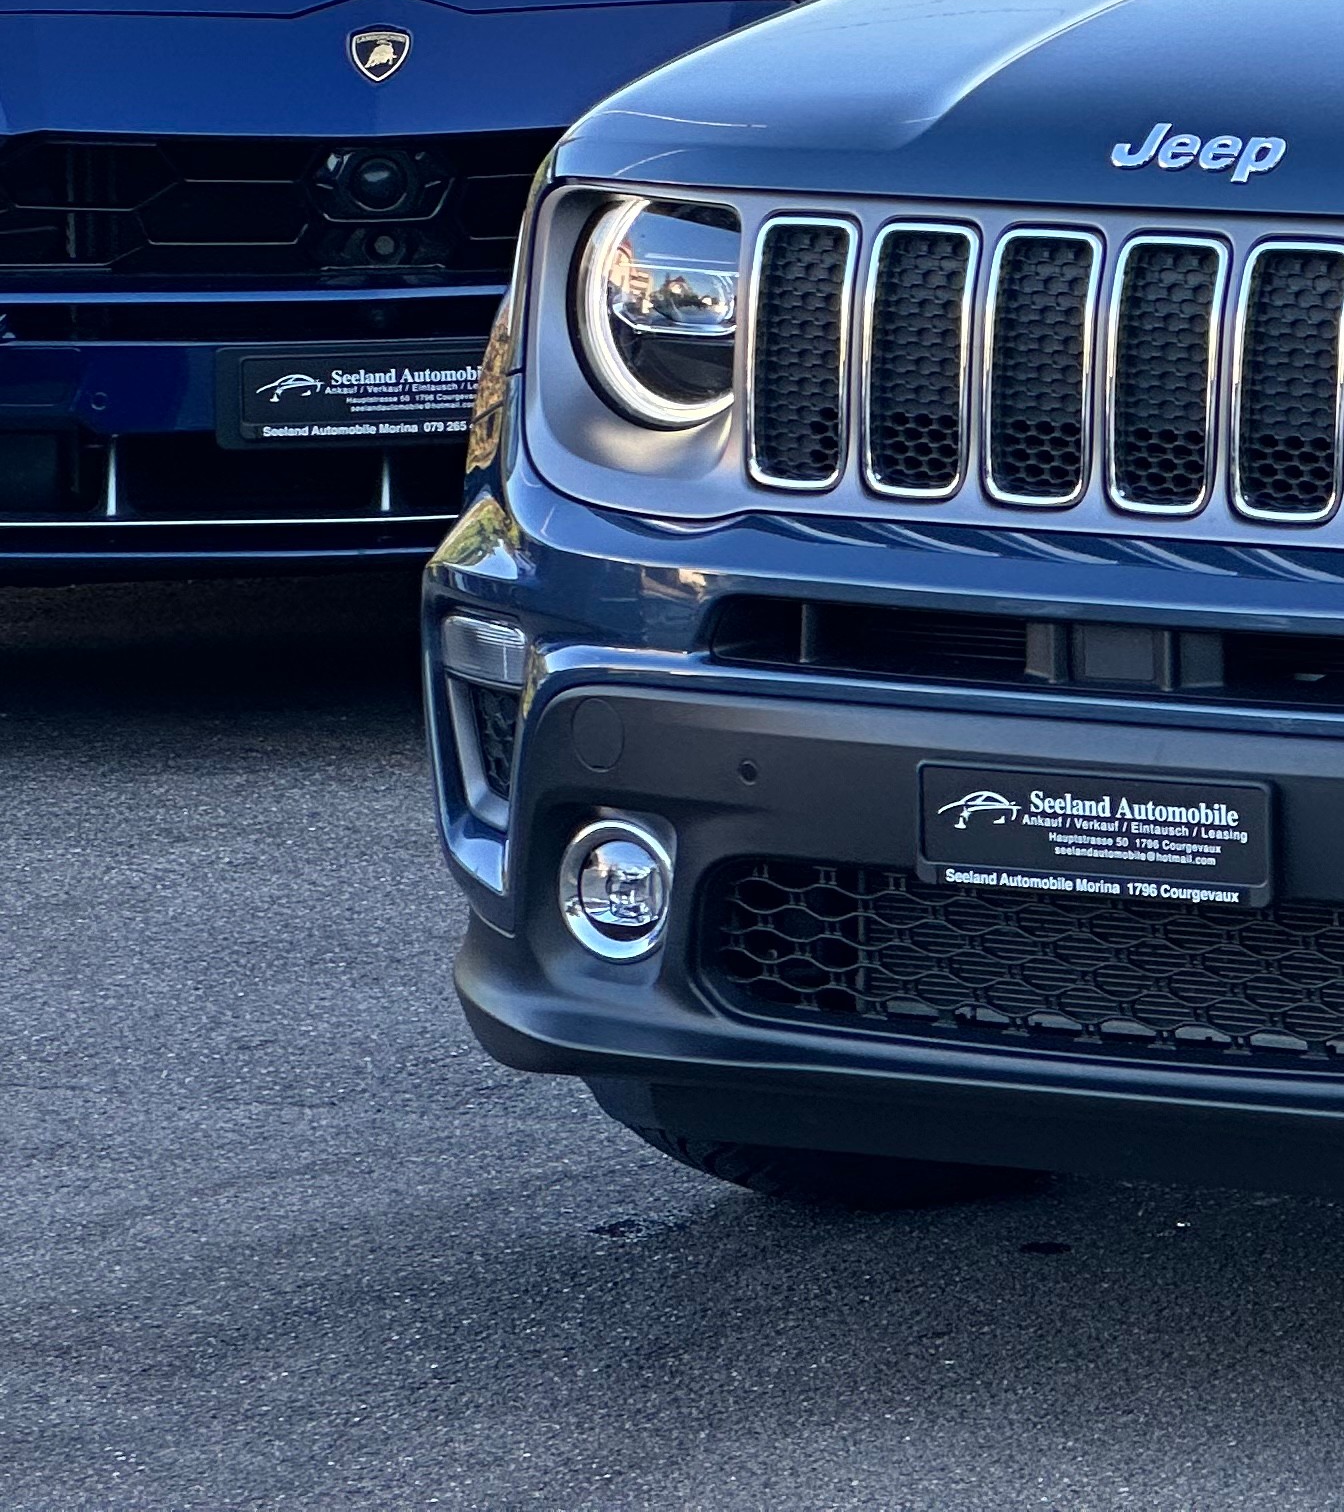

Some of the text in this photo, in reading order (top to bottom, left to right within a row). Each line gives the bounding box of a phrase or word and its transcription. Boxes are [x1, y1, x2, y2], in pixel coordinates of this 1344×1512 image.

[1111, 122, 1288, 184] Jeep
[331, 368, 397, 385] Seeland
[262, 426, 309, 437] Seeland
[311, 424, 377, 436] Automobile
[379, 423, 418, 434] Morina
[423, 422, 444, 433] 079
[446, 421, 467, 432] 265
[1030, 790, 1239, 826] Seeland Automobile
[1022, 814, 1248, 844] Ankauf / Verkauf / Eintausch / Leasing
[1048, 832, 1113, 846] Hauptstrasse
[1115, 836, 1129, 847] 50
[1161, 839, 1221, 854] Courgevaux
[1054, 846, 1217, 866] seelandautomobile@hotmail.com
[945, 868, 1240, 903] Seeland Automobile Morina 1796 Courgevaux
